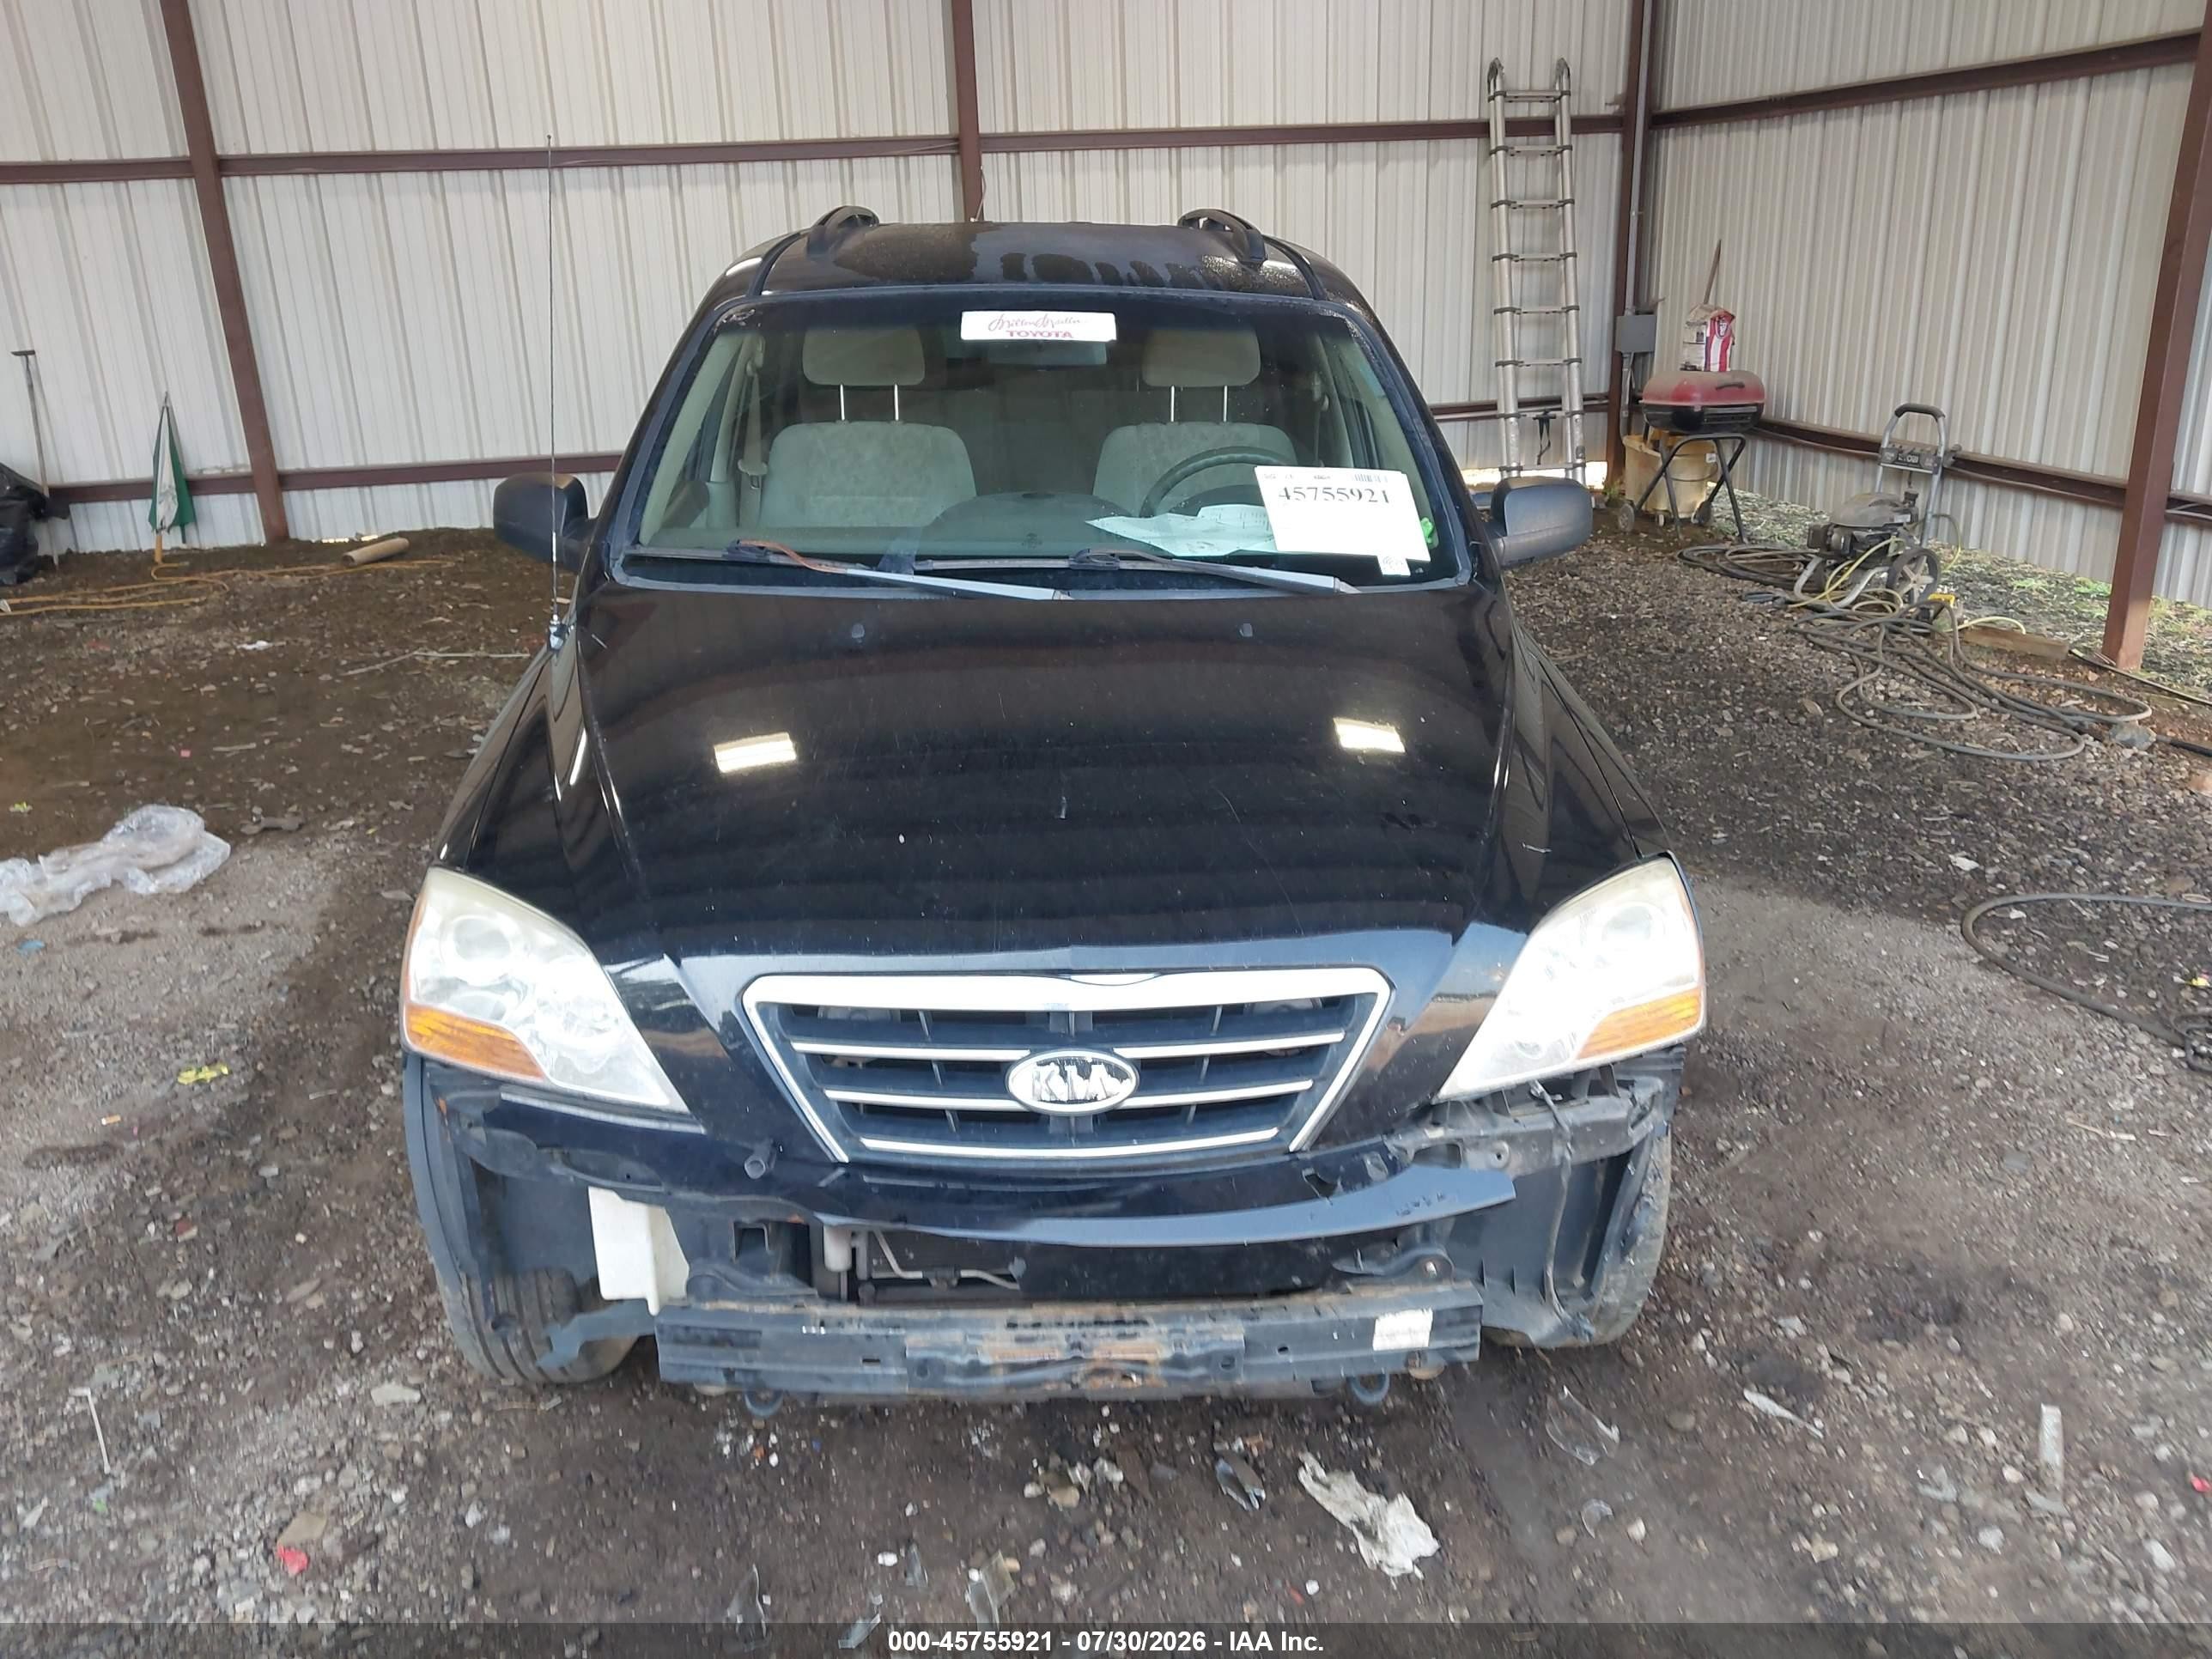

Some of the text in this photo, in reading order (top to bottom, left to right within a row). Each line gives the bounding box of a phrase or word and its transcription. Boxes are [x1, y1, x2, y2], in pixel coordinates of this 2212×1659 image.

[1006, 330, 1073, 338] TOYOTA
[1278, 486, 1390, 504] 45755921
[1031, 1064, 1120, 1103] KIA
